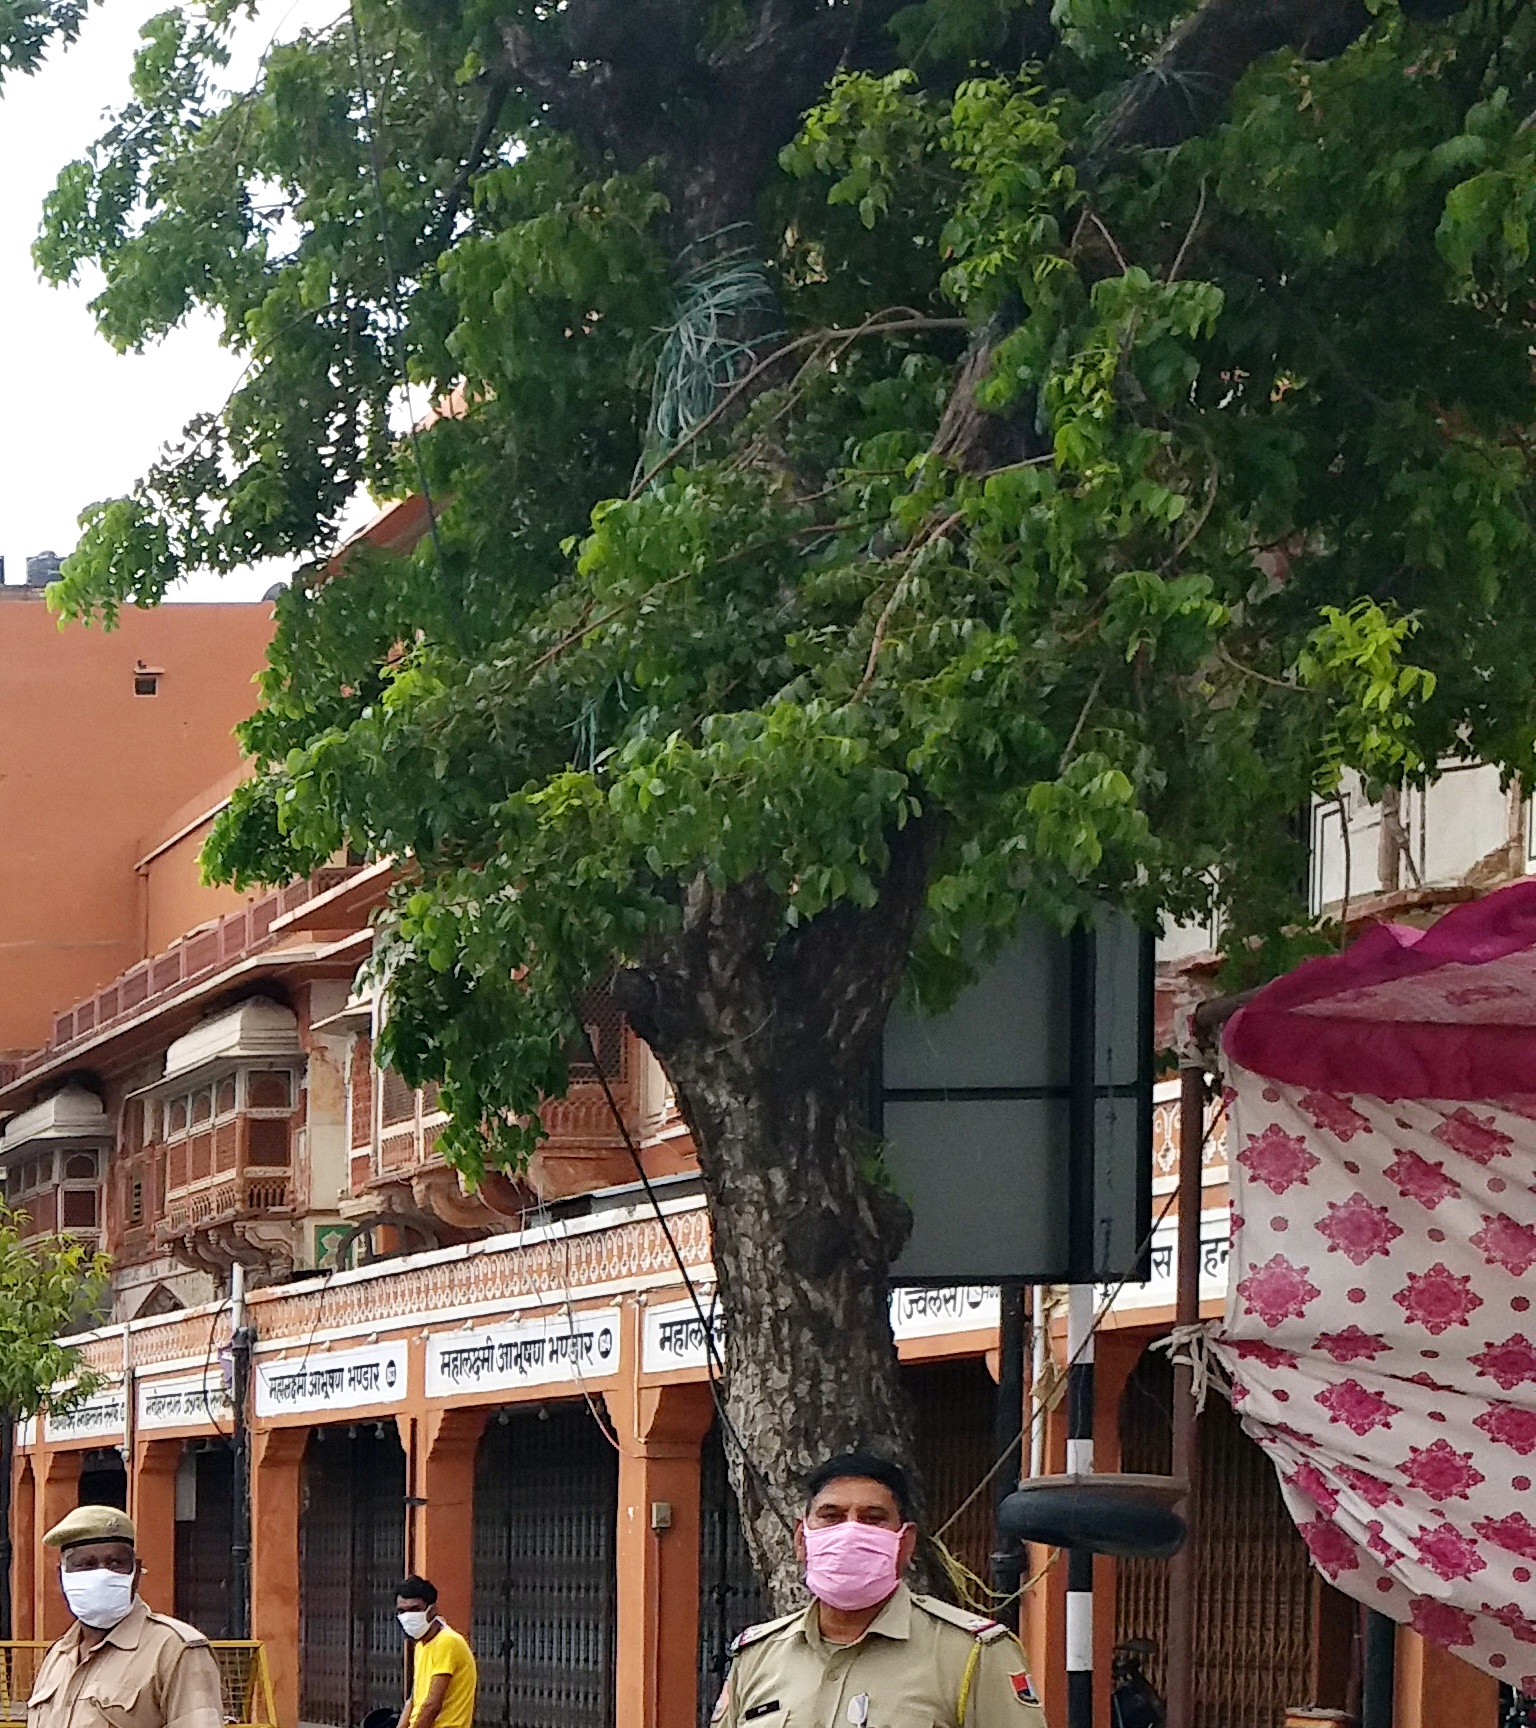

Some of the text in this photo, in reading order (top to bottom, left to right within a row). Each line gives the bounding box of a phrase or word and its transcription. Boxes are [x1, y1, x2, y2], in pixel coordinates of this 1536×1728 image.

[439, 1336, 495, 1384] महालक्ष्मी
[497, 1337, 545, 1375] आभूषण
[549, 1330, 594, 1366] भण्डार
[659, 1314, 727, 1357] महाल
[308, 1367, 344, 1399] आभूषण
[348, 1362, 380, 1392] भण्डार
